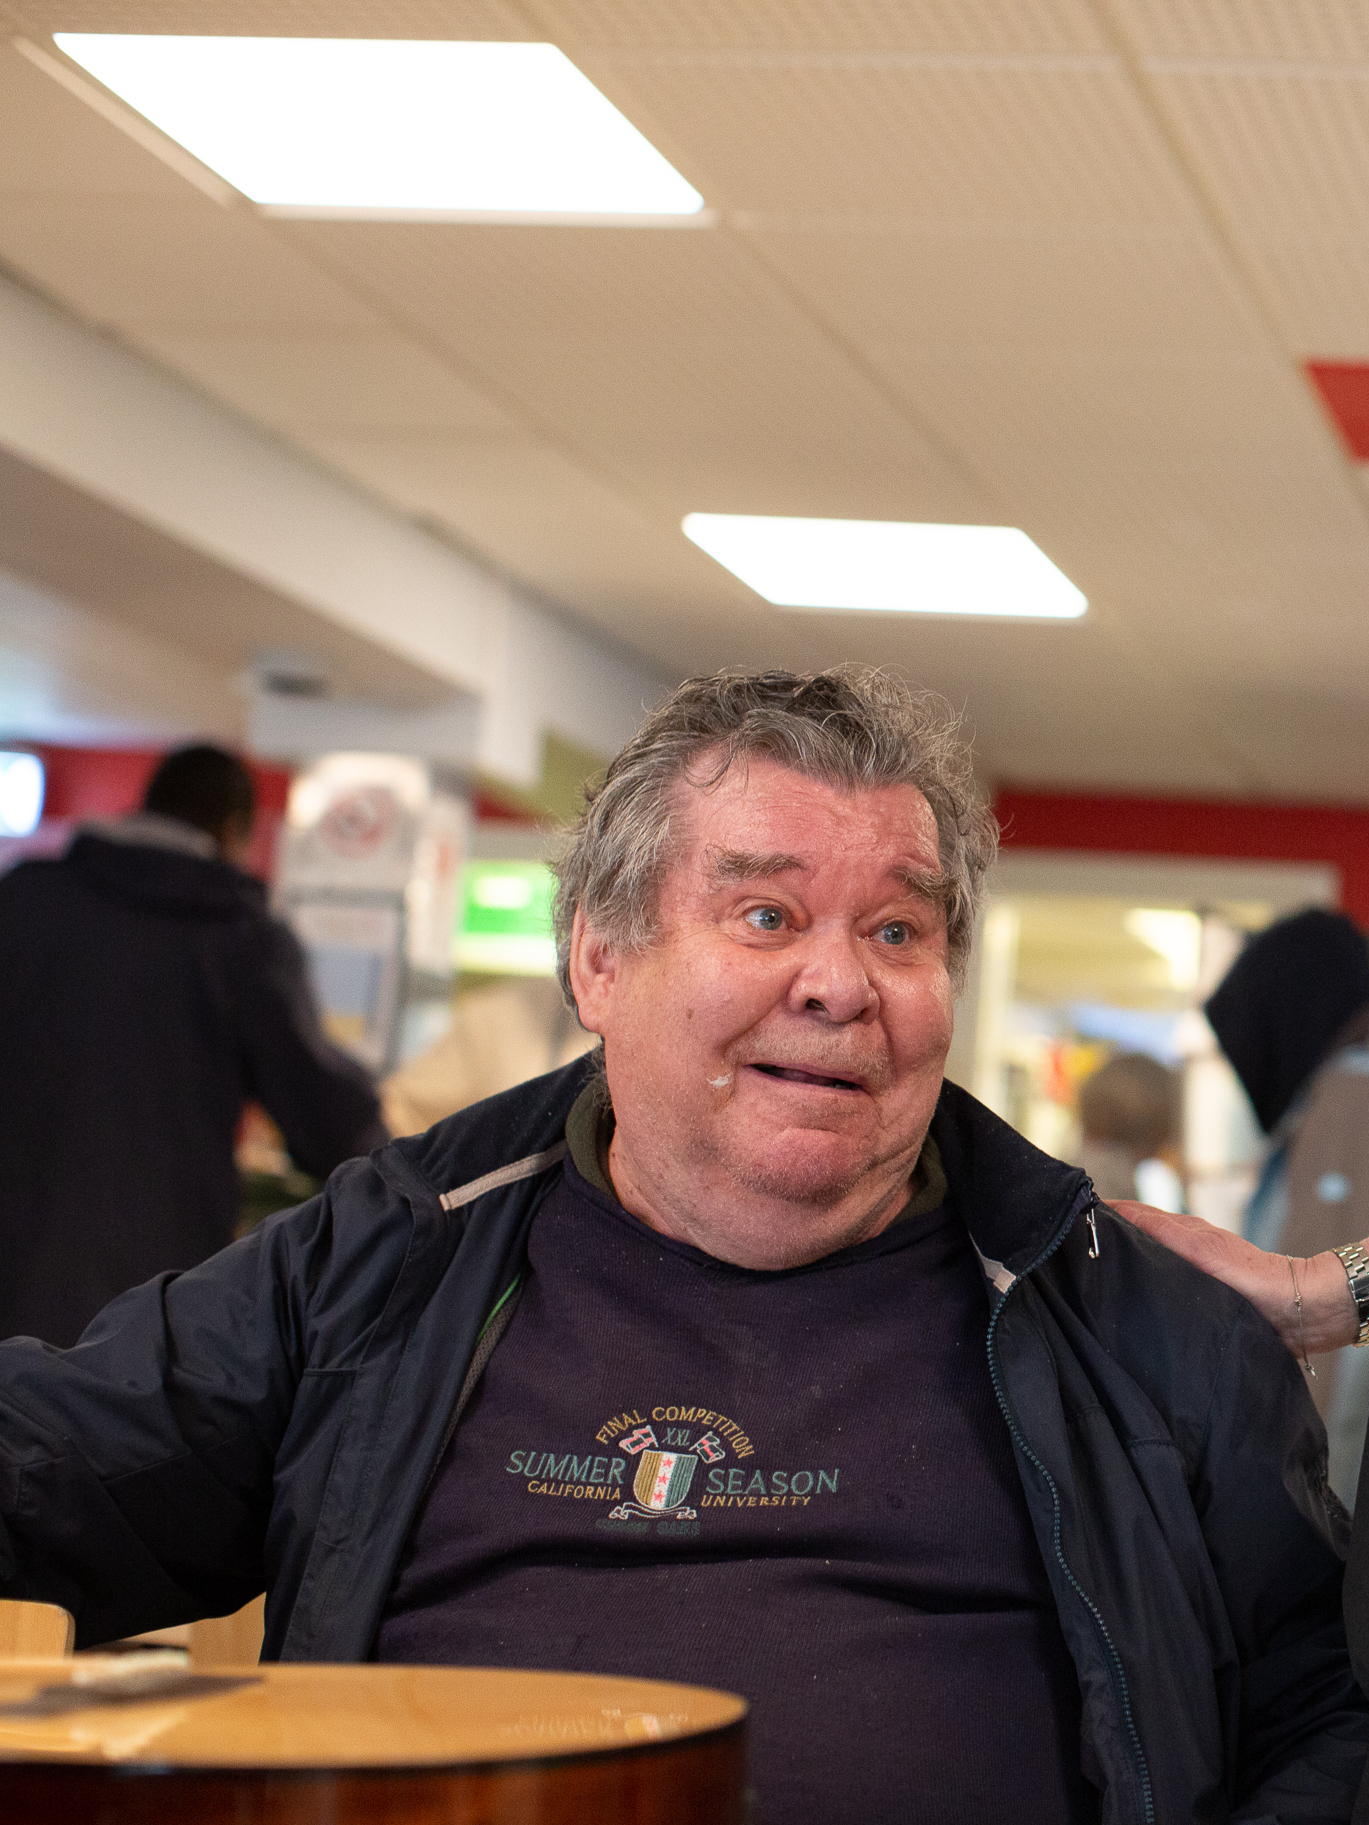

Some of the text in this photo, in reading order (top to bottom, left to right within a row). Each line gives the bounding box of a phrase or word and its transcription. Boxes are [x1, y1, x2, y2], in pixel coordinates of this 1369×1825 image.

[595, 1406, 755, 1459] FINAL COMPETITION
[505, 1451, 840, 1496] SUMMER SEASON
[527, 1480, 811, 1507] CALIFORNIA UNIVERSITY
